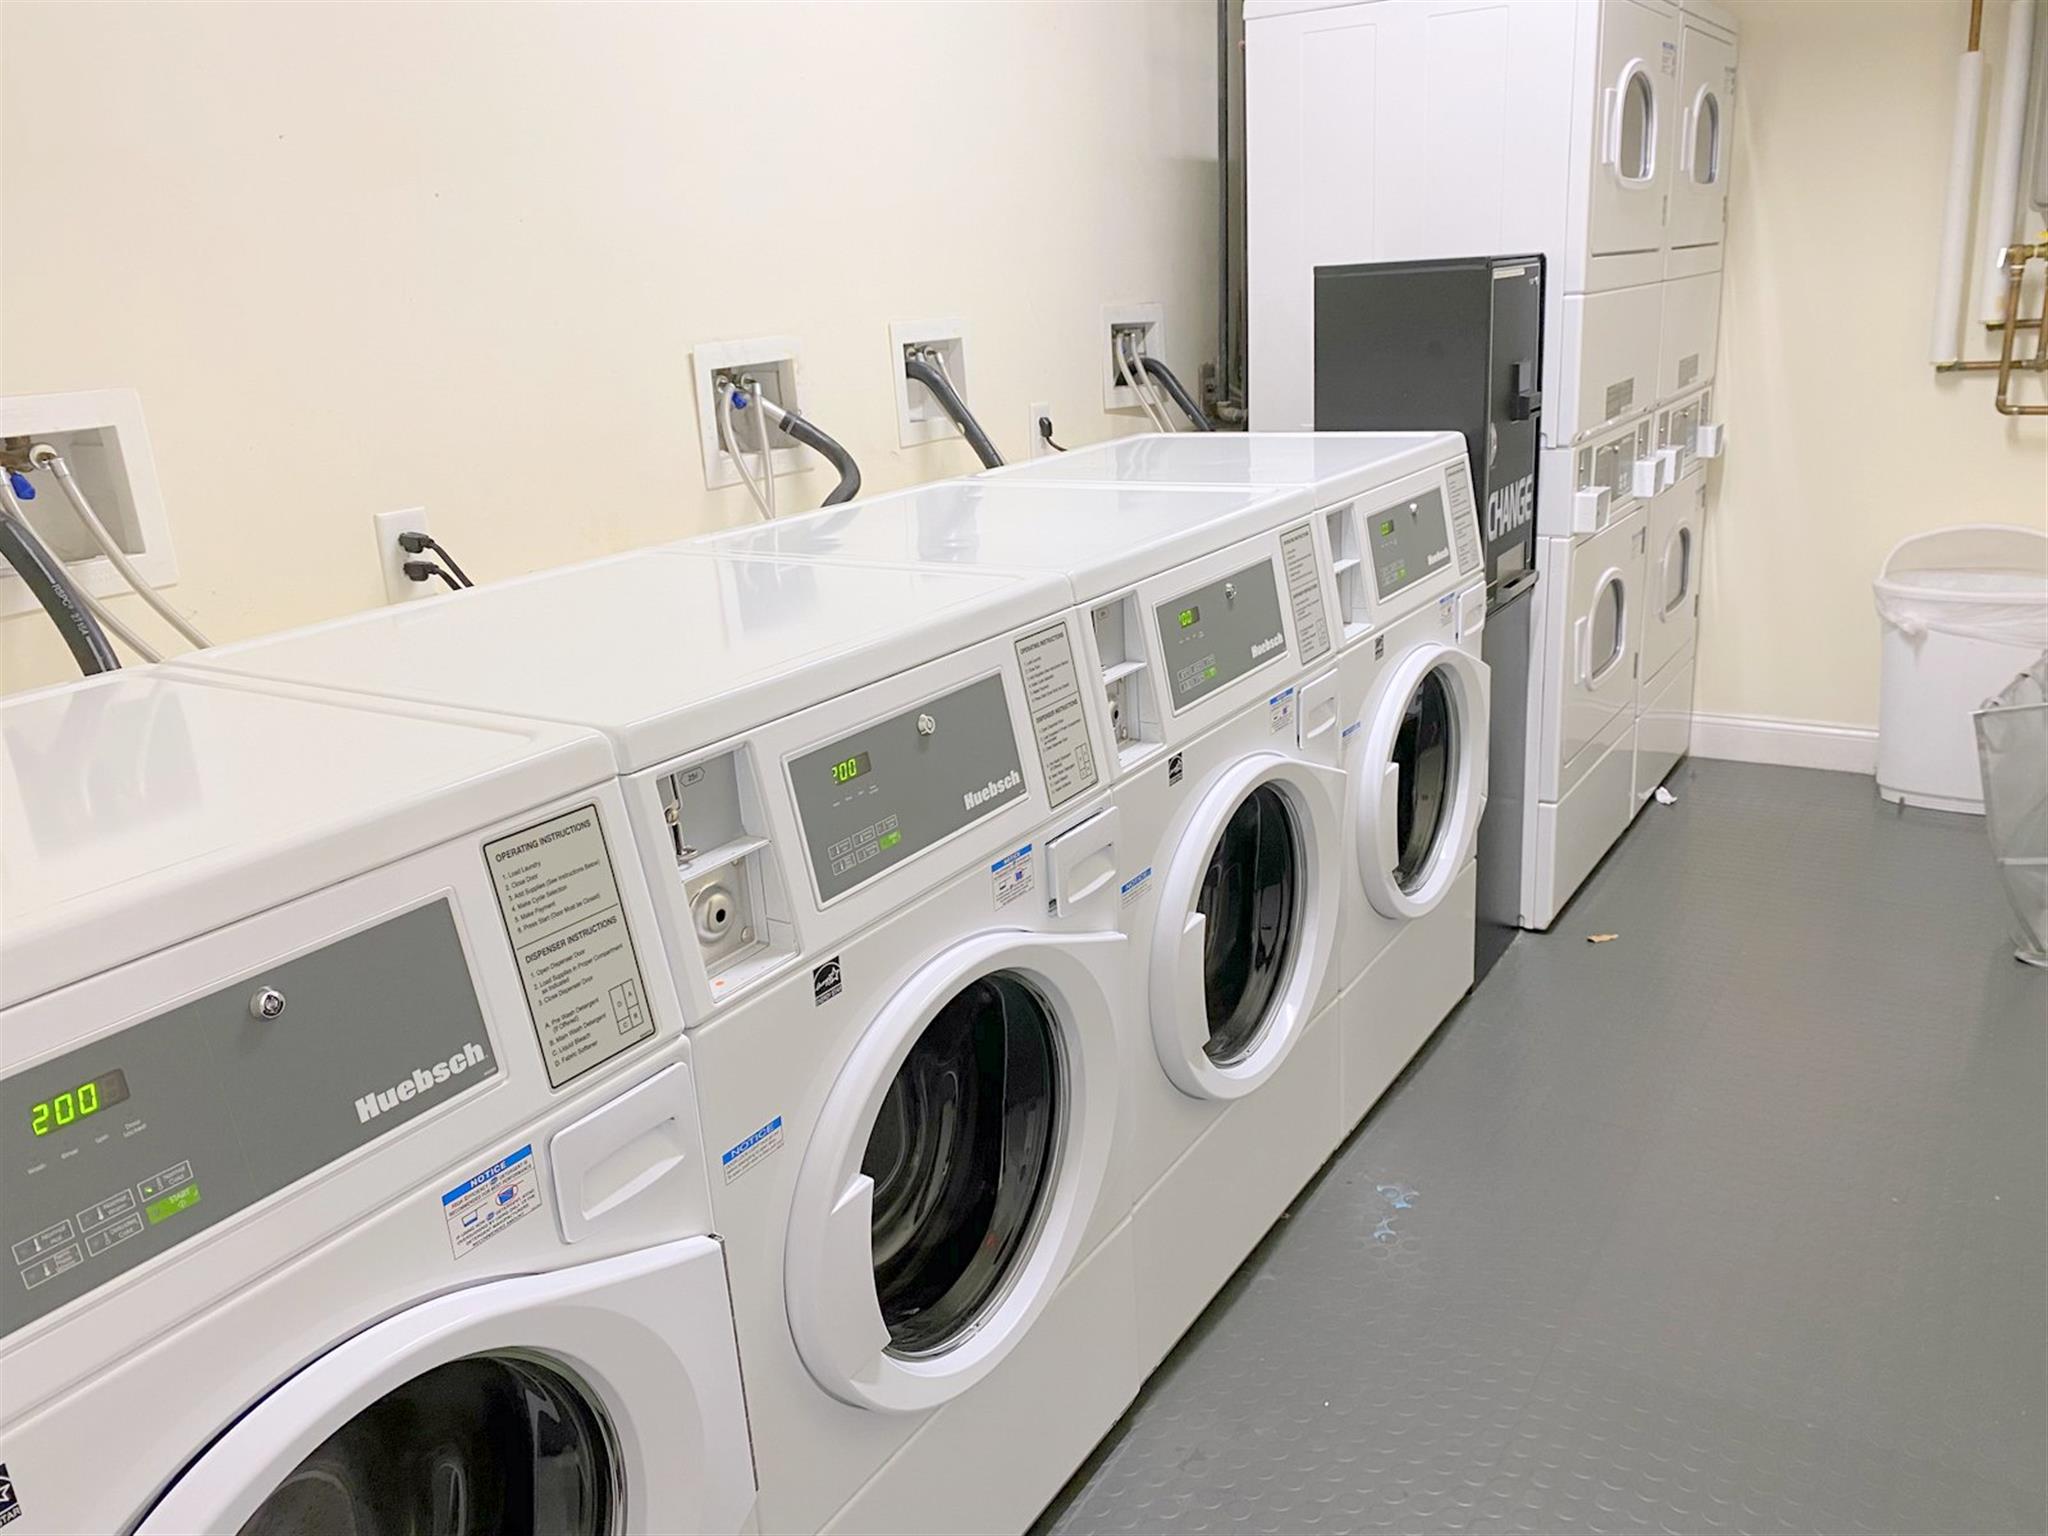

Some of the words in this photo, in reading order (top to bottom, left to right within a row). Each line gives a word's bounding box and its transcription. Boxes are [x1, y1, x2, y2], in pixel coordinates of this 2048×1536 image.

[1488, 473, 1533, 542] CHANGE
[963, 770, 1020, 810] Huebsch
[495, 839, 538, 862] OPERATING
[538, 818, 591, 845] INSTRUCTIONS
[508, 868, 520, 877] Load
[521, 860, 541, 873] Laundry
[511, 878, 525, 888] Close
[526, 873, 538, 882] Door
[514, 890, 524, 898] Add
[525, 881, 545, 895] Supplies
[517, 899, 531, 909] Make
[532, 893, 545, 904] Cycle
[546, 884, 567, 897] Selection
[520, 910, 533, 919] Make
[535, 900, 556, 914] Payment
[523, 920, 537, 930] Press
[524, 939, 566, 964] DISPENSER
[566, 915, 617, 944] INSTRUCTIONS
[536, 965, 549, 976] Open
[550, 954, 573, 969] Dispenser
[573, 948, 585, 957] Door
[539, 977, 551, 987] Load
[552, 967, 571, 981] Supplies
[577, 958, 592, 969] Proper
[593, 943, 623, 961] Compartment
[544, 992, 557, 1003] Close
[558, 981, 581, 996] Dispenser
[581, 974, 593, 984] Door
[551, 1017, 560, 1025] Pre
[561, 1010, 574, 1020] Wash
[575, 997, 599, 1014] Detergent
[556, 1032, 568, 1042] Main
[569, 1025, 582, 1035] Wash
[583, 1012, 606, 1029] Detergent
[558, 1041, 574, 1053] Liquid
[574, 1032, 590, 1044] Bleach
[561, 1051, 576, 1063] Fabric
[577, 1039, 598, 1055] Softener
[355, 1043, 485, 1124] Huebsch
[32, 1083, 98, 1136] 200
[731, 1125, 773, 1159] NOTICE
[470, 1162, 506, 1187] NOTICE
